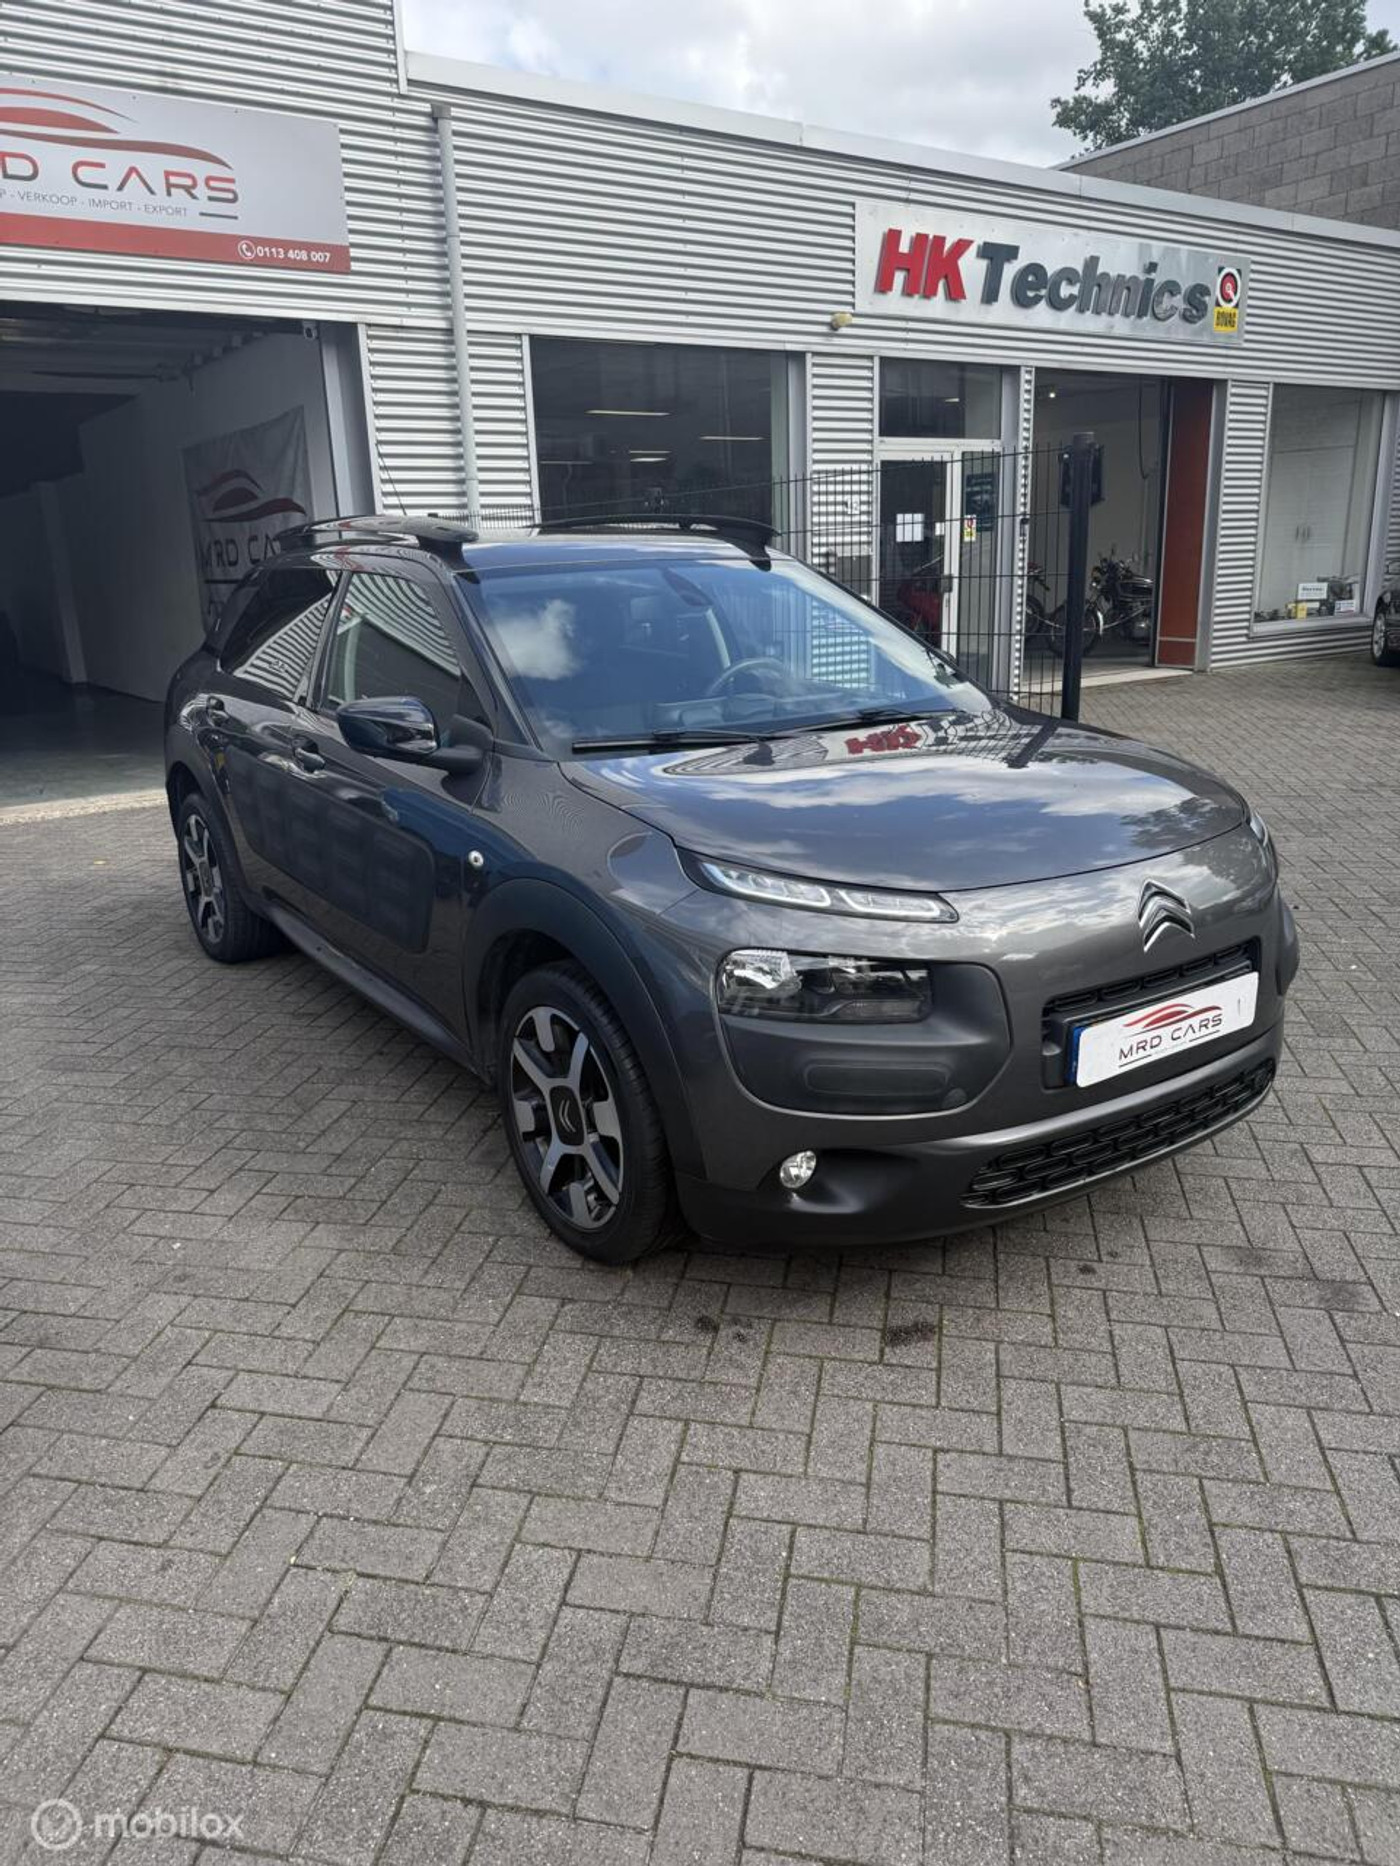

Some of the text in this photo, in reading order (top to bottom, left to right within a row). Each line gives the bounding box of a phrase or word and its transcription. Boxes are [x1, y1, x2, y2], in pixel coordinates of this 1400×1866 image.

[17, 190, 77, 206] VERKOOP
[88, 198, 134, 212] IMPORT
[144, 203, 187, 217] EXPORT
[71, 160, 239, 204] CARS
[256, 246, 285, 259] 0113
[310, 251, 331, 263] 007
[875, 228, 1212, 325] HK Technics
[1118, 1034, 1162, 1061] MRD
[1171, 1013, 1223, 1041] CARS
